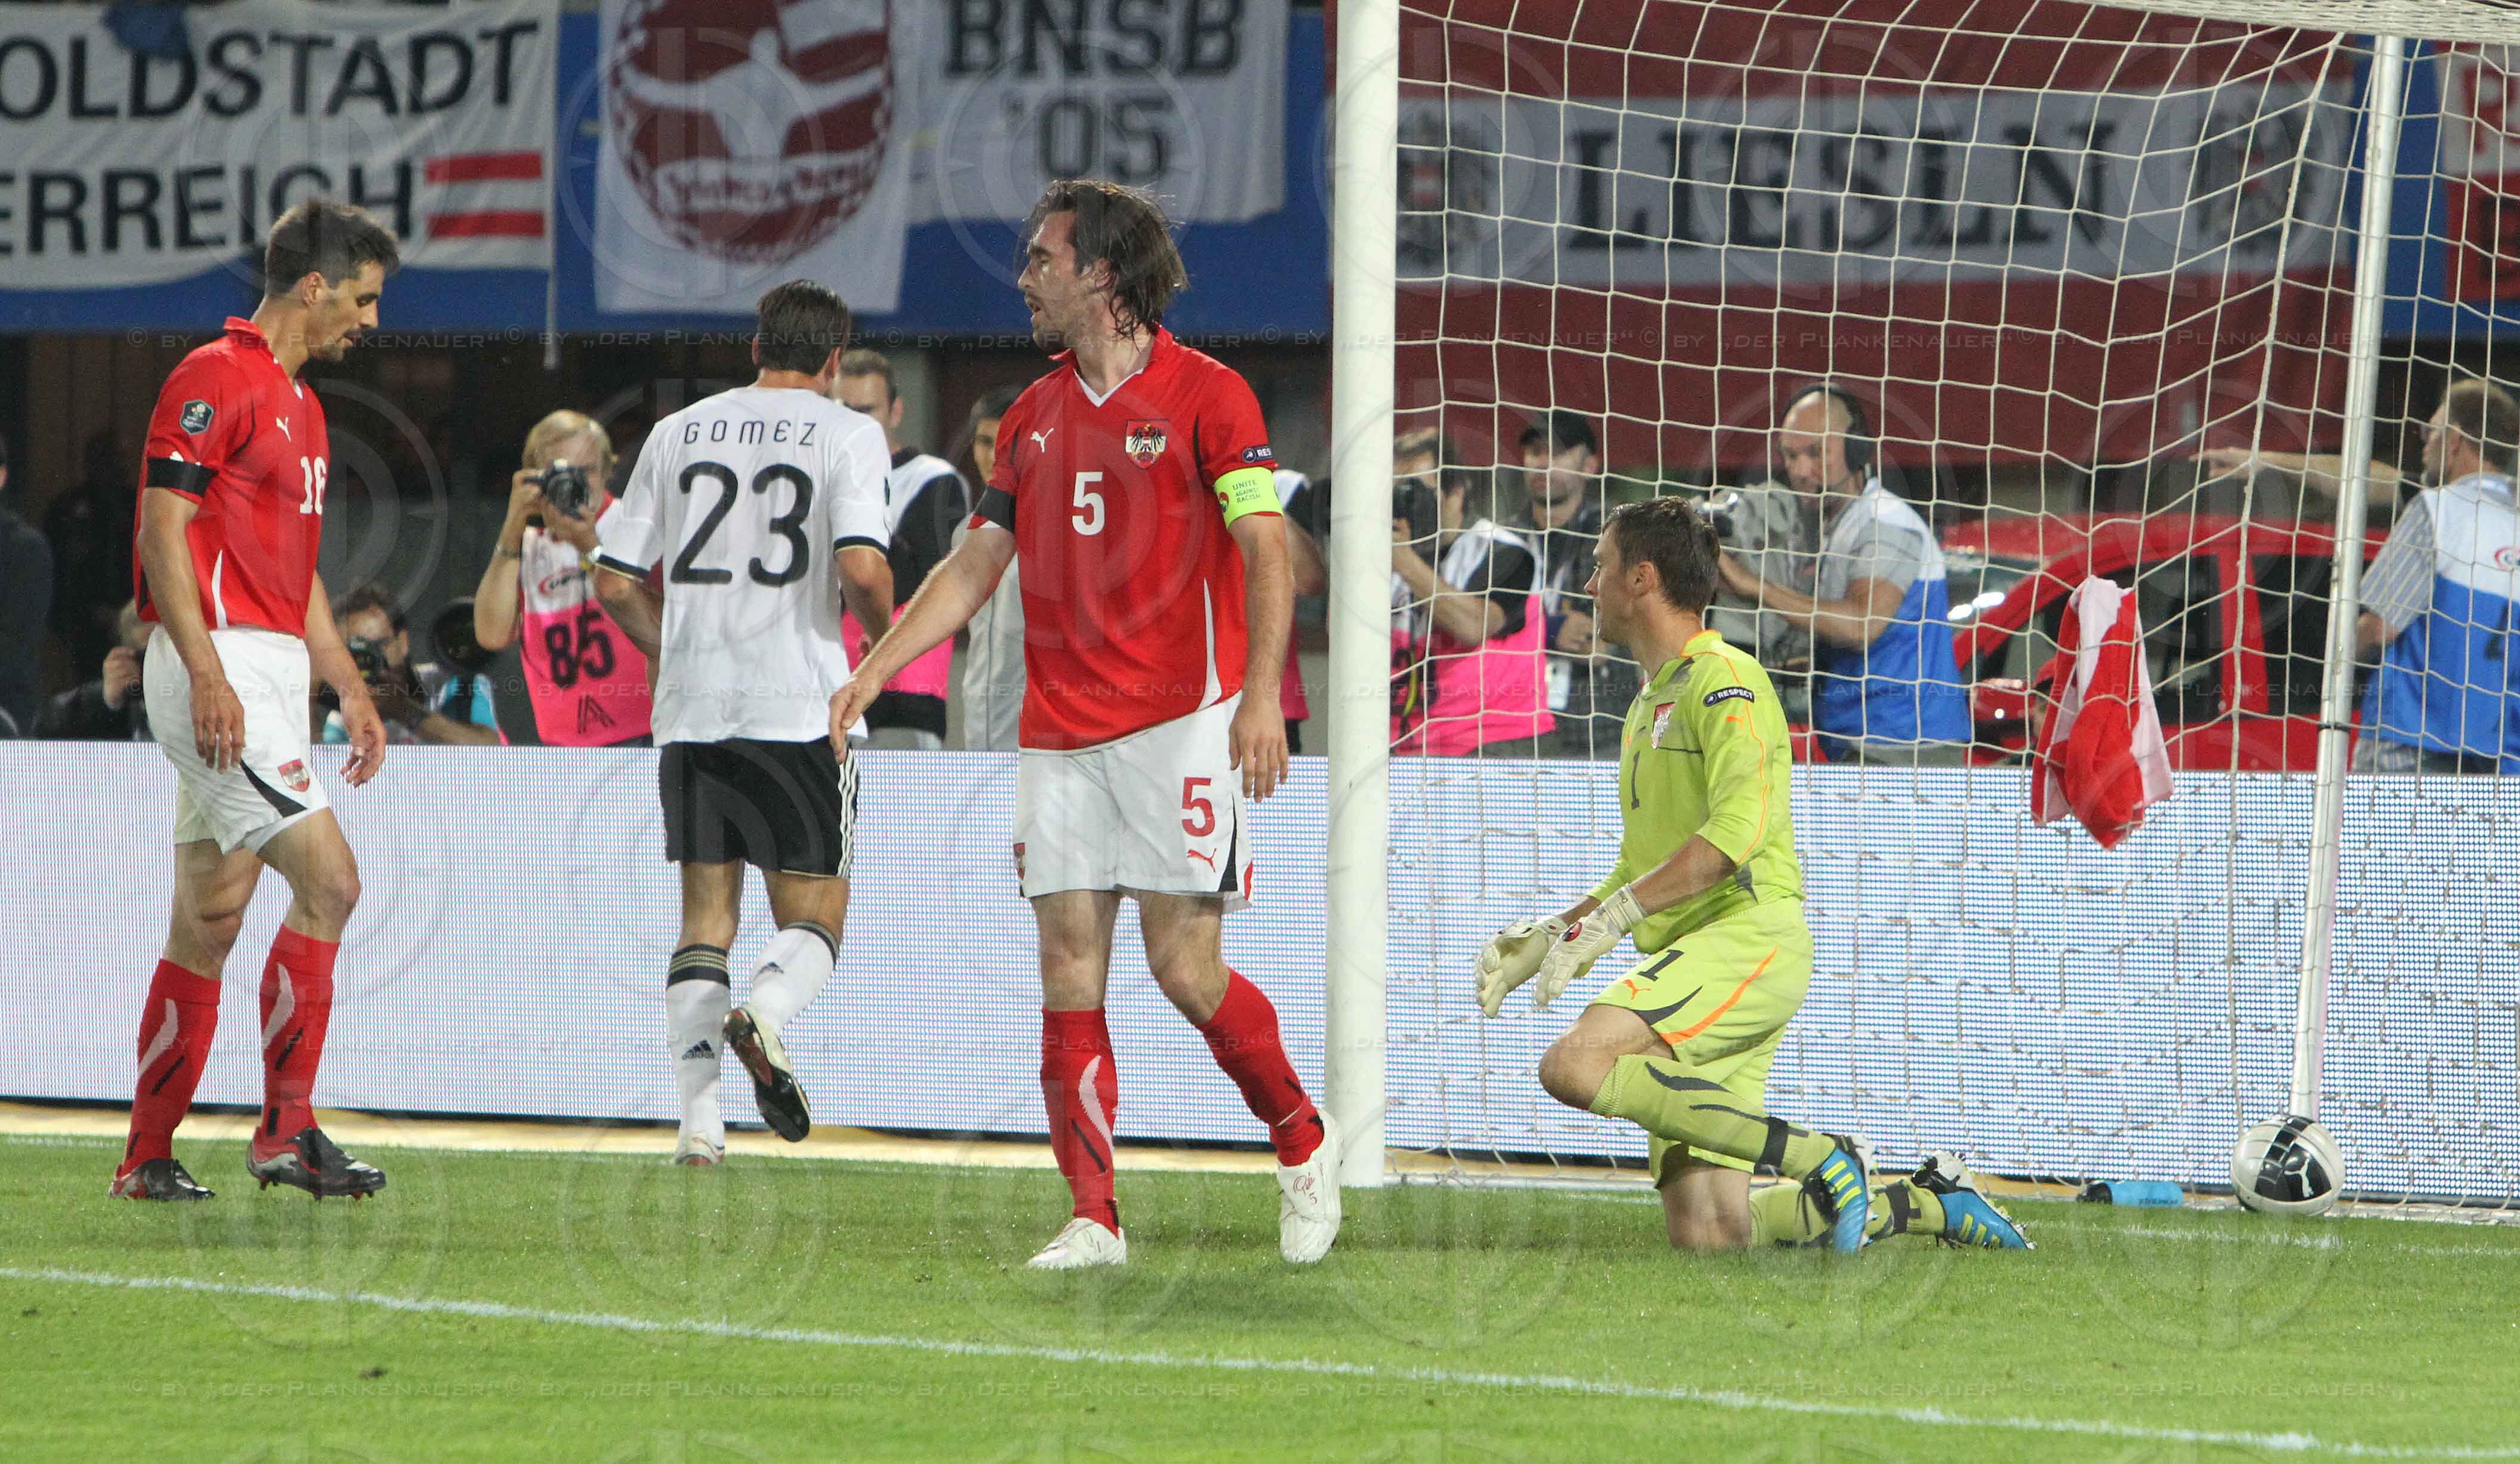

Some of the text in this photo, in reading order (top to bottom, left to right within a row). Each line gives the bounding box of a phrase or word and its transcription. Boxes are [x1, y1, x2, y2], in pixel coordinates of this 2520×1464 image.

[946, 0, 1242, 78] BNSB
[0, 159, 413, 257] RREICH
[684, 420, 817, 446] GOMEZ
[299, 456, 326, 515] 16
[1072, 472, 1105, 535] 5
[670, 461, 813, 588] 23
[545, 610, 616, 691] 85
[1717, 688, 1753, 700] RESPECT
[1181, 777, 1215, 837] 5
[1636, 949, 1685, 982] 1
